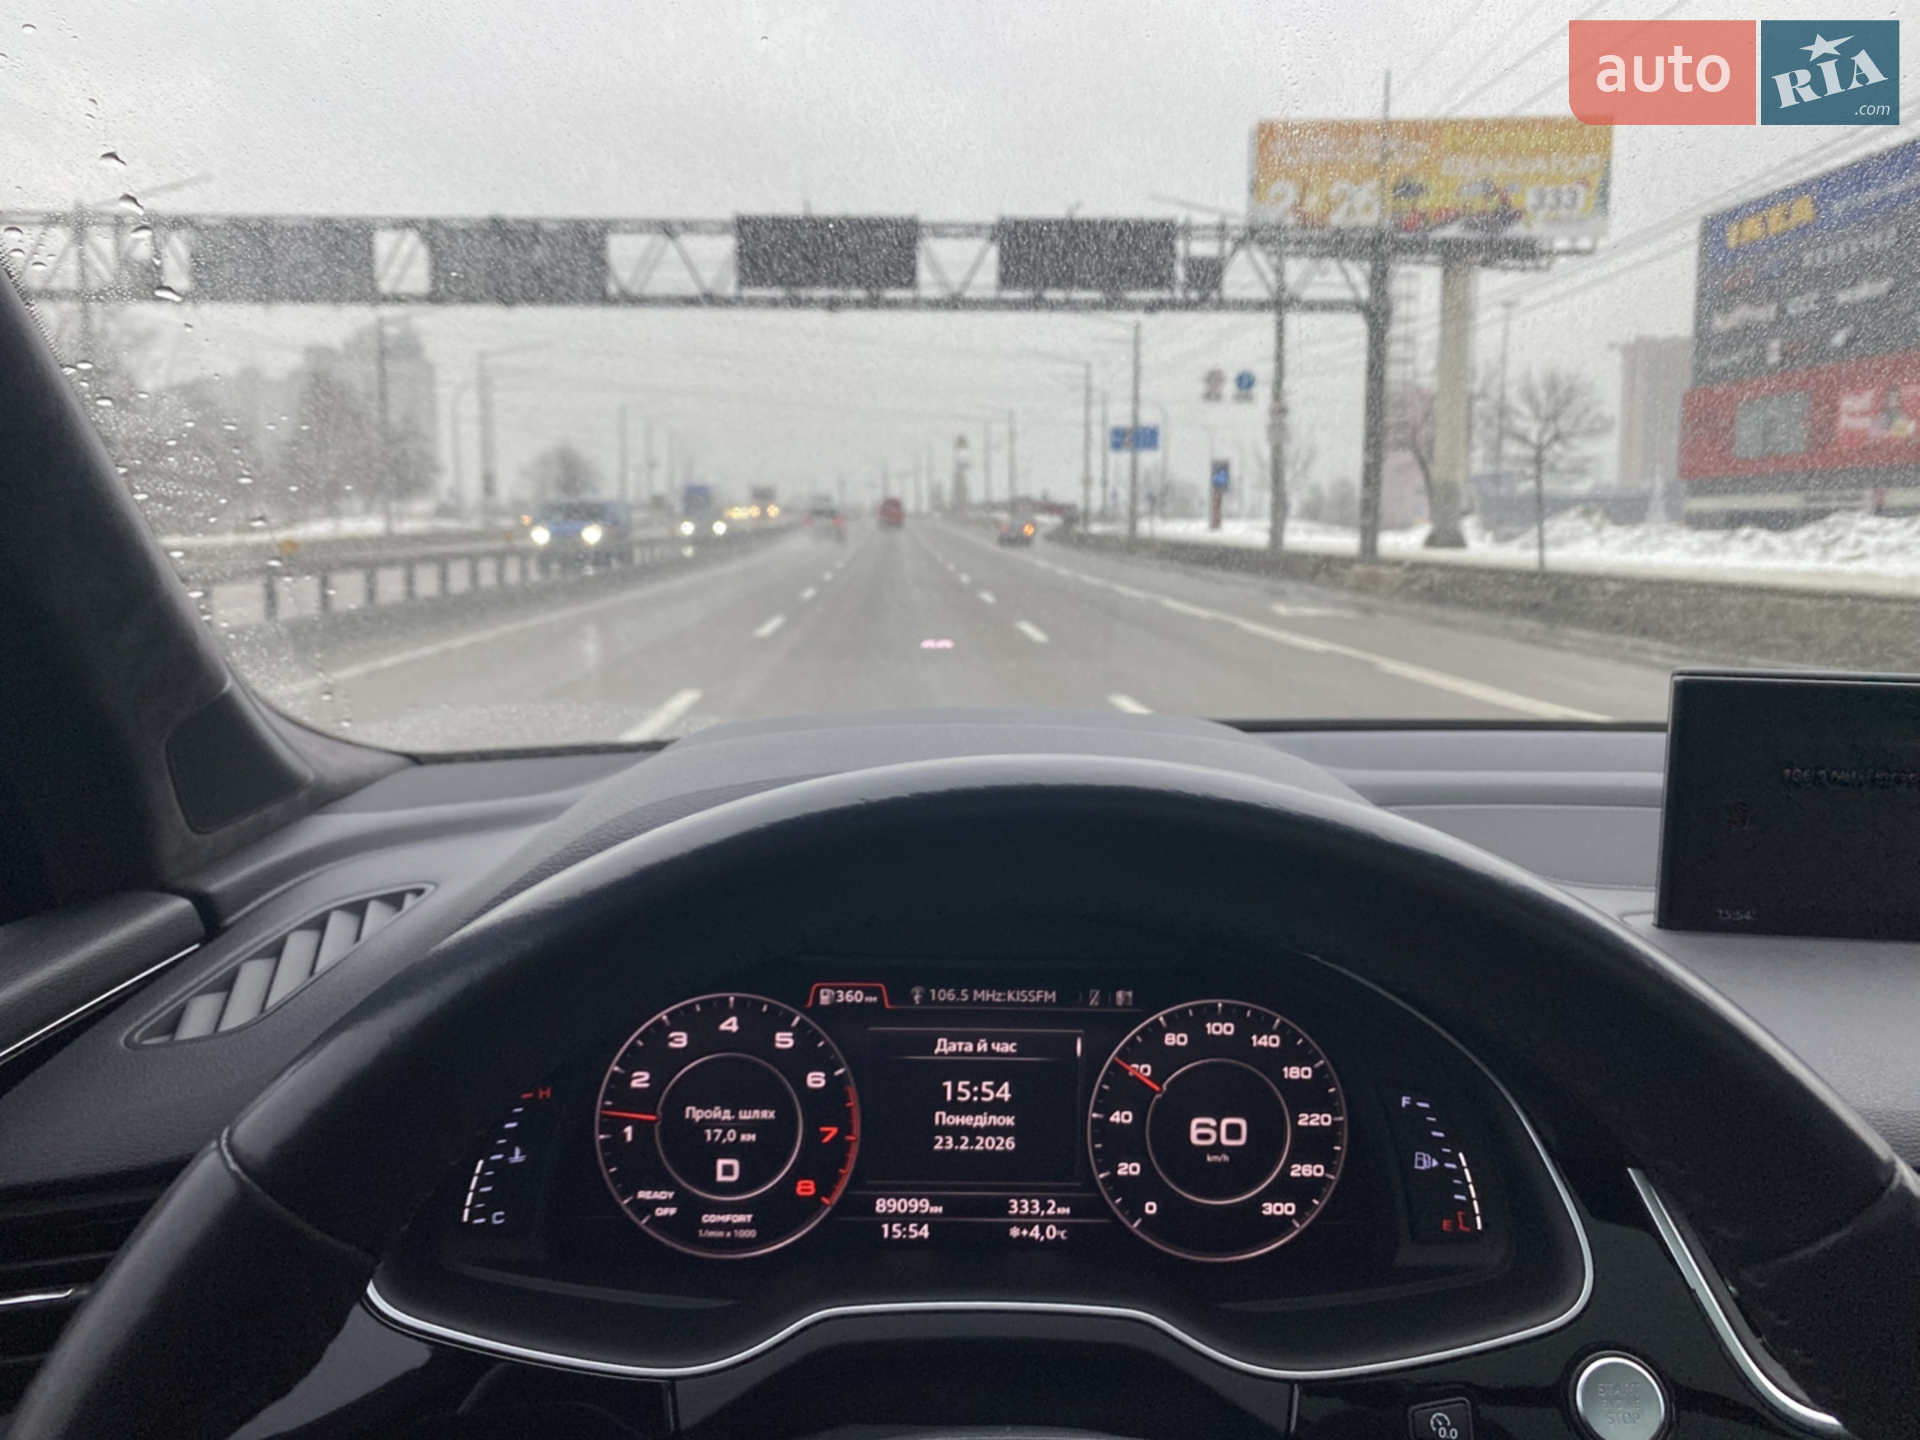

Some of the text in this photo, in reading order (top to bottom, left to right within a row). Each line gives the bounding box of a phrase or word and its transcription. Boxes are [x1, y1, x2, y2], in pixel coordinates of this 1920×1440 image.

[929, 989, 969, 1001] 106.5
[719, 1017, 739, 1032] 4
[1205, 1022, 1235, 1036] 100
[668, 1033, 688, 1048] 3
[775, 1034, 794, 1048] 5
[935, 1038, 1018, 1054] Дата й час
[1164, 1033, 1188, 1047] 80
[1251, 1034, 1280, 1048] 140
[630, 1071, 650, 1088] 2
[807, 1072, 826, 1088] 6
[1282, 1066, 1312, 1080] 180
[538, 1088, 552, 1099] H
[942, 1080, 1012, 1102] 15:54
[1402, 1097, 1411, 1108] F
[685, 1106, 776, 1123] Пройд. шлях
[934, 1111, 1015, 1128] Понеділок
[1109, 1110, 1133, 1124] 40
[1298, 1113, 1332, 1126] 220
[623, 1126, 633, 1142] 1
[704, 1129, 736, 1143] 17,0
[819, 1126, 838, 1143] 7
[1189, 1117, 1248, 1147] 60
[933, 1135, 1016, 1151] 23.2.2026
[1206, 1152, 1230, 1164] km/h
[716, 1158, 740, 1182] D
[1117, 1162, 1141, 1175] 20
[1290, 1164, 1325, 1177] 260
[637, 1190, 675, 1200] READY
[796, 1180, 816, 1196] 8
[655, 1207, 678, 1217] OFF
[1145, 1202, 1157, 1214] 0
[1261, 1202, 1296, 1216] 300
[492, 1211, 505, 1224] C
[701, 1214, 753, 1223] COMFORT
[881, 1222, 930, 1239] 15:54
[1598, 1383, 1640, 1396] START
[1606, 1412, 1640, 1425] STOP
[1438, 1427, 1458, 1440] 0.0
